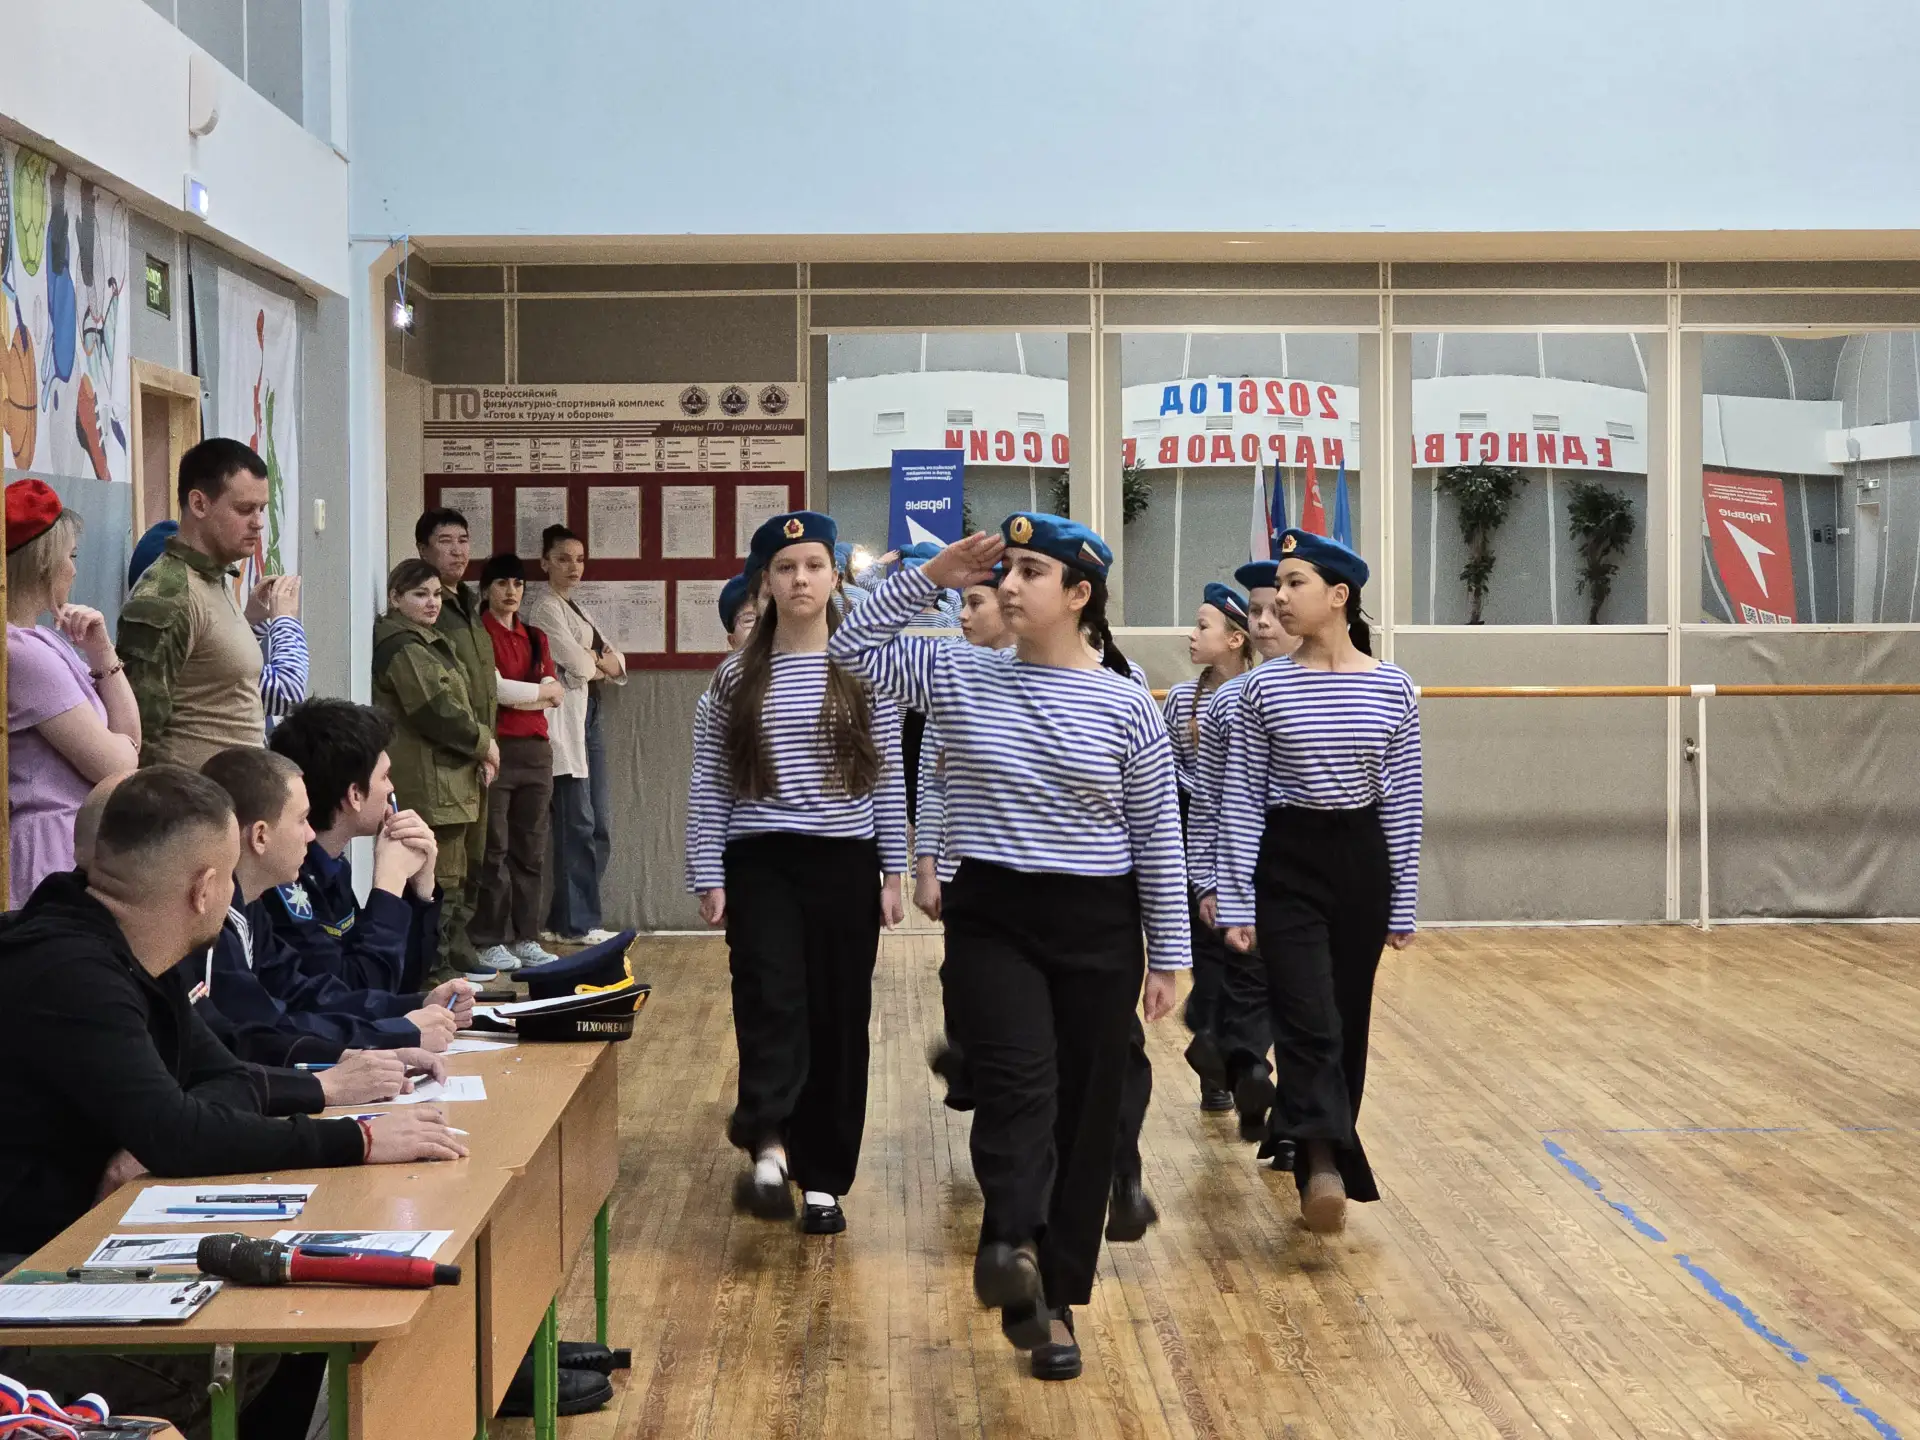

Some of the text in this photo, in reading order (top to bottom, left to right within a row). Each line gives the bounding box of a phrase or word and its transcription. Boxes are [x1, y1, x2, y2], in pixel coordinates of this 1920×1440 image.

[483, 388, 558, 399] Всероссийский
[433, 387, 480, 420] ГТО
[483, 399, 665, 410] физкультурно-спортивный комплекс
[484, 410, 516, 419] «Готов
[527, 411, 555, 421] труду
[567, 410, 614, 420] обороне»
[672, 423, 704, 433] Нормы
[706, 422, 725, 431] ГТО
[732, 423, 763, 433] нормы
[764, 423, 794, 431] жизни
